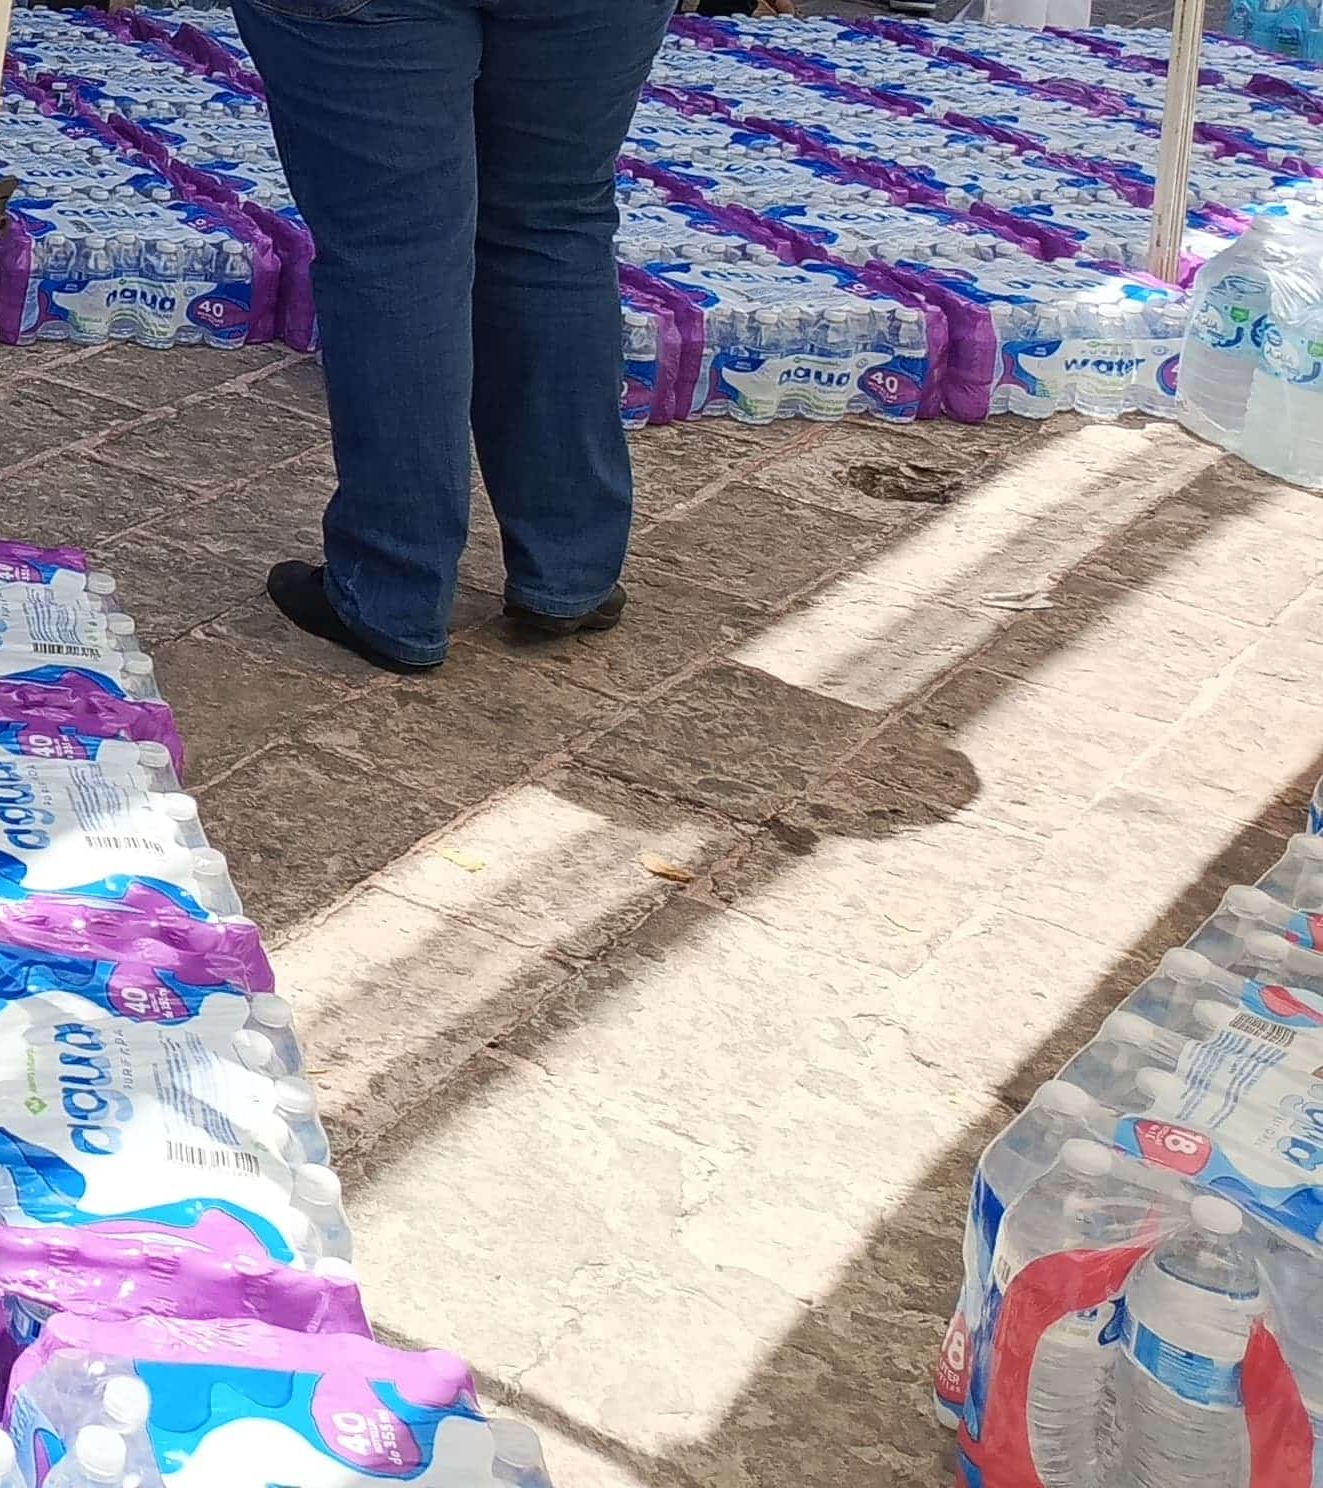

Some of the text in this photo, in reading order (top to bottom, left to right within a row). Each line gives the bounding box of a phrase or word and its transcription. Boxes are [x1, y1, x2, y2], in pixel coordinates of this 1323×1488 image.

[105, 287, 176, 312] agua
[198, 299, 224, 318] 40
[1064, 358, 1146, 378] water
[870, 371, 899, 394] 40
[24, 731, 54, 759] 40
[123, 984, 151, 1015] 40
[57, 1020, 137, 1157] agua
[1162, 1128, 1205, 1156] 18
[332, 1411, 369, 1457] 40
